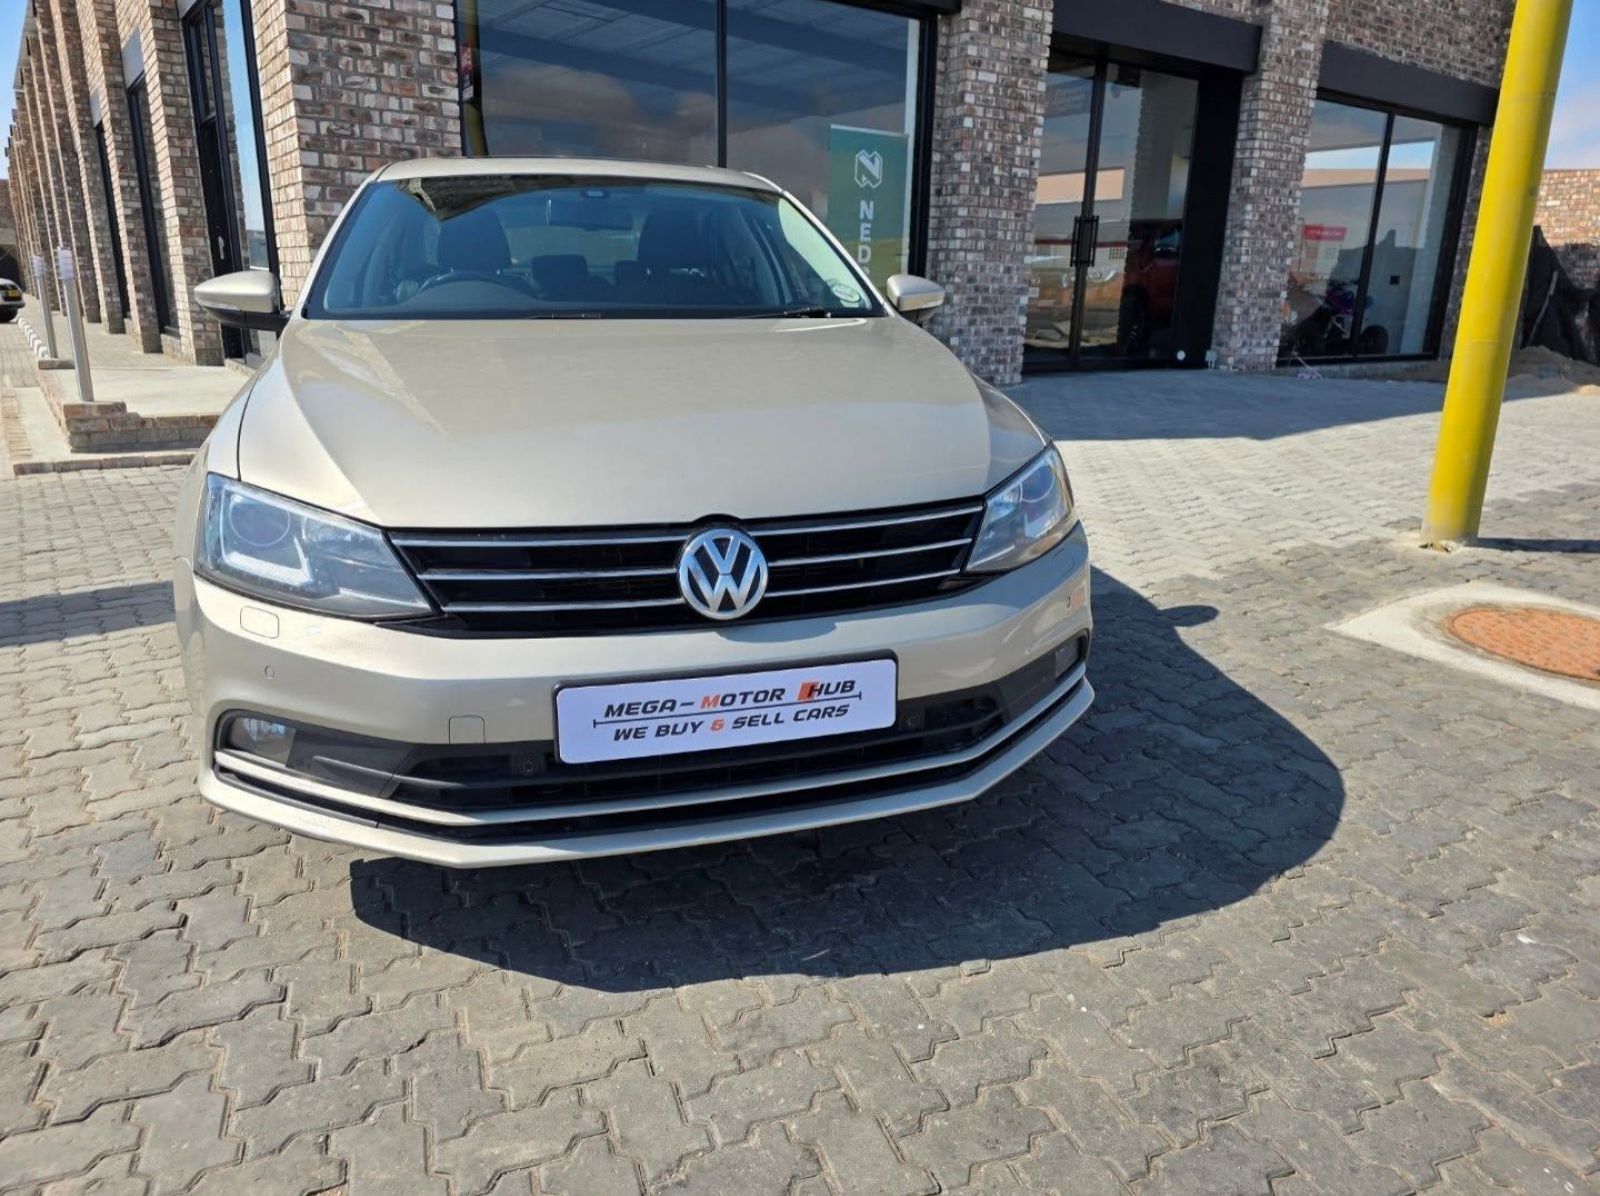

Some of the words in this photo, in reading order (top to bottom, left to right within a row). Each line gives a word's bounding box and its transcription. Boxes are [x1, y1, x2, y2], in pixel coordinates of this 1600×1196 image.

[701, 687, 786, 710] MOTOR
[806, 679, 856, 698] HUB
[613, 726, 649, 741] WE
[654, 721, 704, 738] BUY
[731, 711, 785, 730] SELL
[793, 704, 850, 722] CARS
